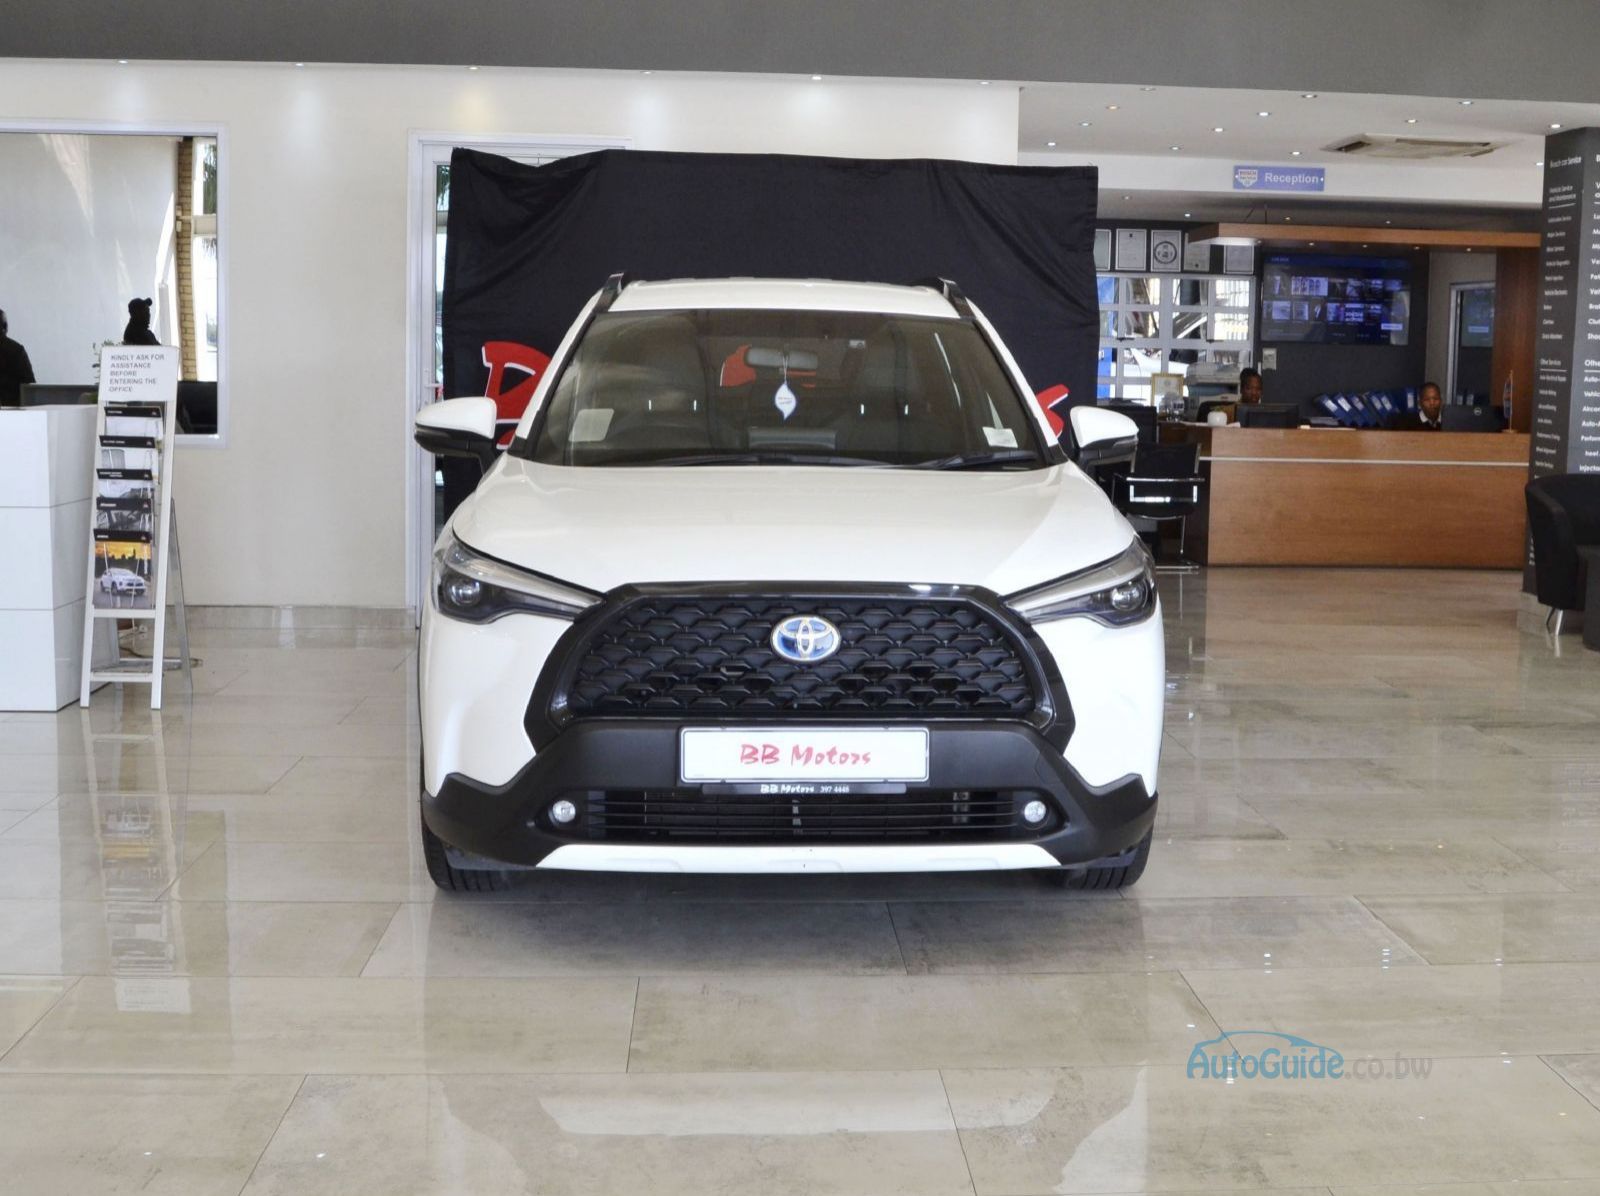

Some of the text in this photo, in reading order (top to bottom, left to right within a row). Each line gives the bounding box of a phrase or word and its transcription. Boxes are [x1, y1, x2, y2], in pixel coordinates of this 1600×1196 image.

[1264, 172, 1319, 185] Reception
[151, 353, 165, 361] FOR
[145, 377, 157, 385] THE
[740, 744, 871, 766] BB Motors
[760, 784, 778, 794] BB
[780, 784, 815, 793] Motors
